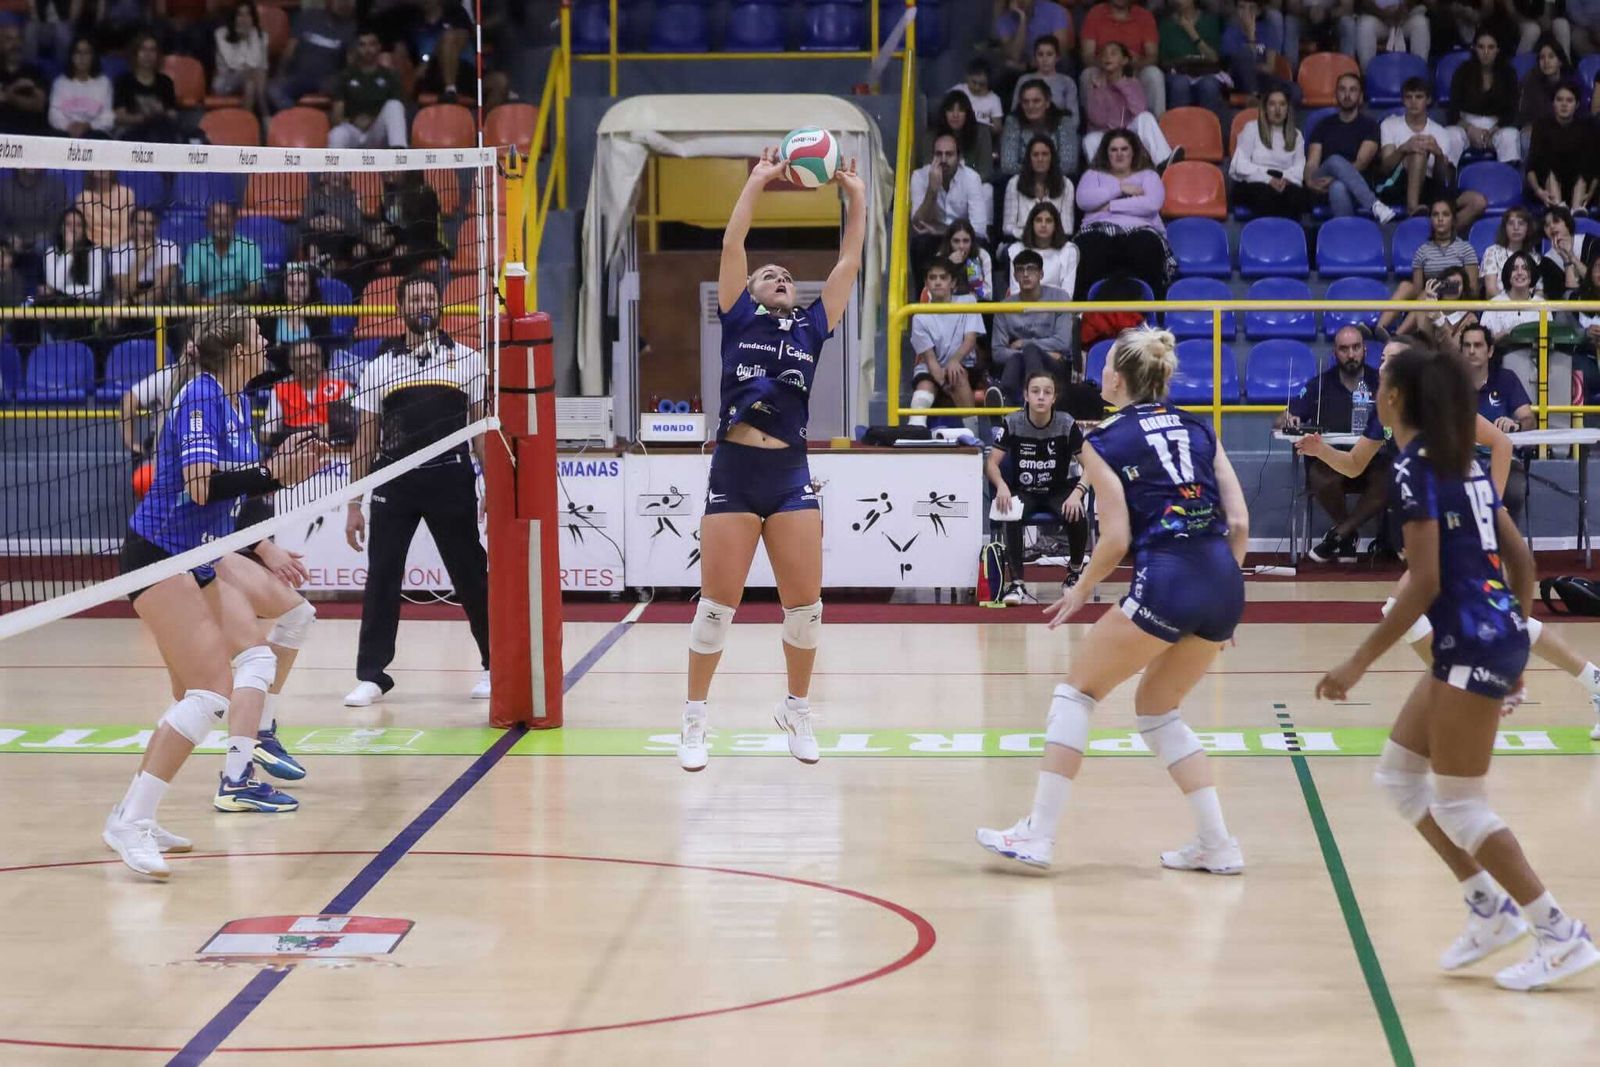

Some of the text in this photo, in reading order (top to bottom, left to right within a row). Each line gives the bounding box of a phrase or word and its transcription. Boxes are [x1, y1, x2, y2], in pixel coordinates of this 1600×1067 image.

[738, 342, 777, 353] Fundación
[652, 424, 694, 432] MONDO
[1145, 429, 1195, 485] 17
[556, 461, 619, 478] MANAS
[1464, 479, 1498, 551] 16
[559, 568, 614, 587] RTES
